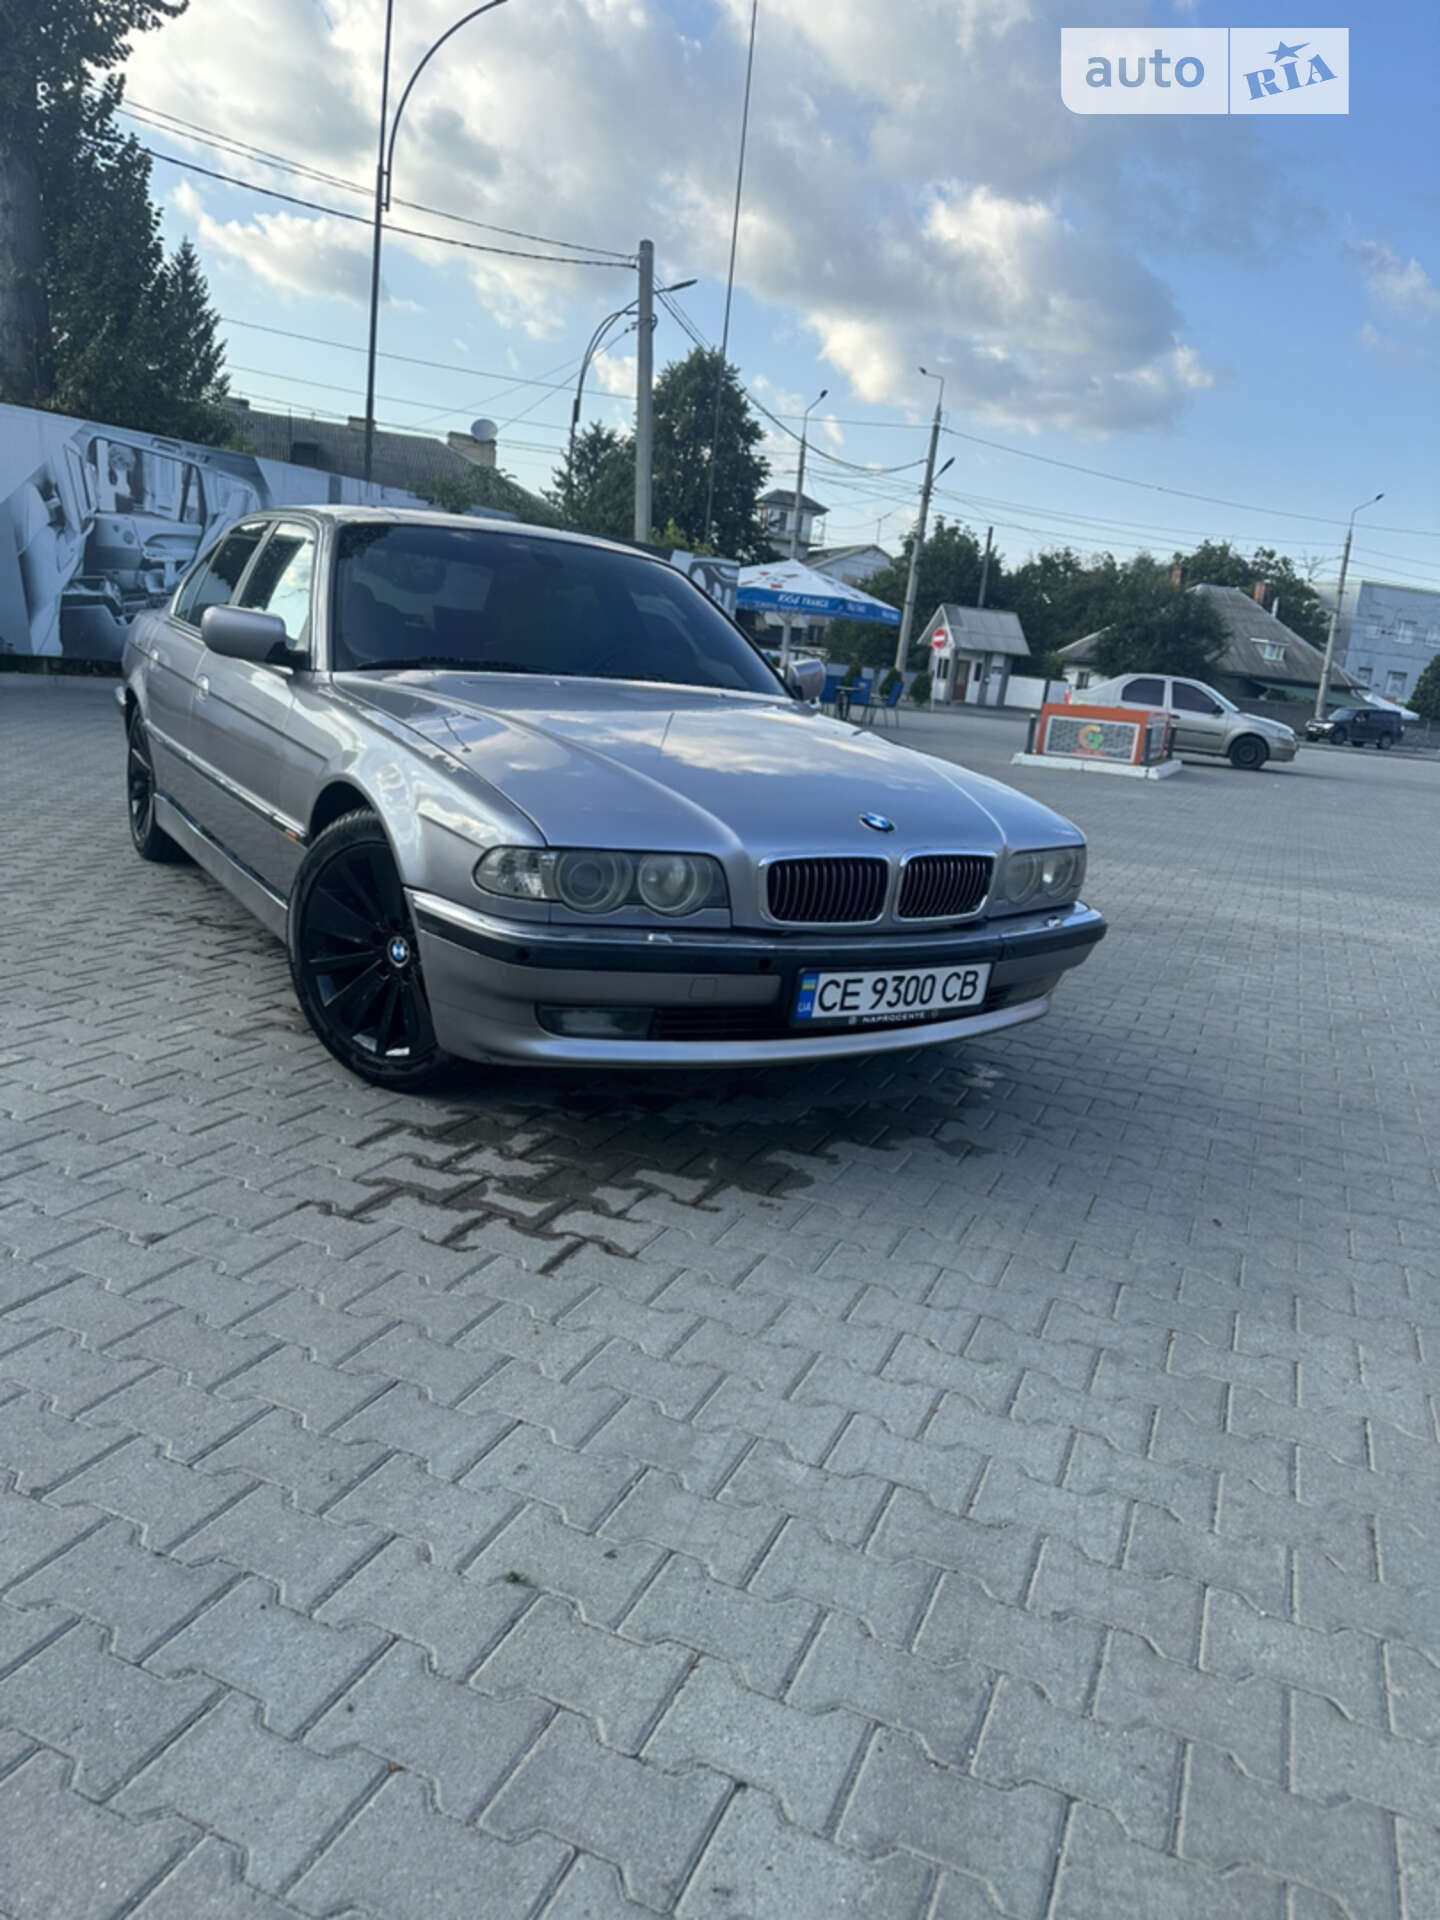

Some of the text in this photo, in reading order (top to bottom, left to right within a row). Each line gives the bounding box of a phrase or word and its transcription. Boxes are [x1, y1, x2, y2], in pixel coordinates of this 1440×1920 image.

[818, 970, 979, 1012] CE 9300 CB
